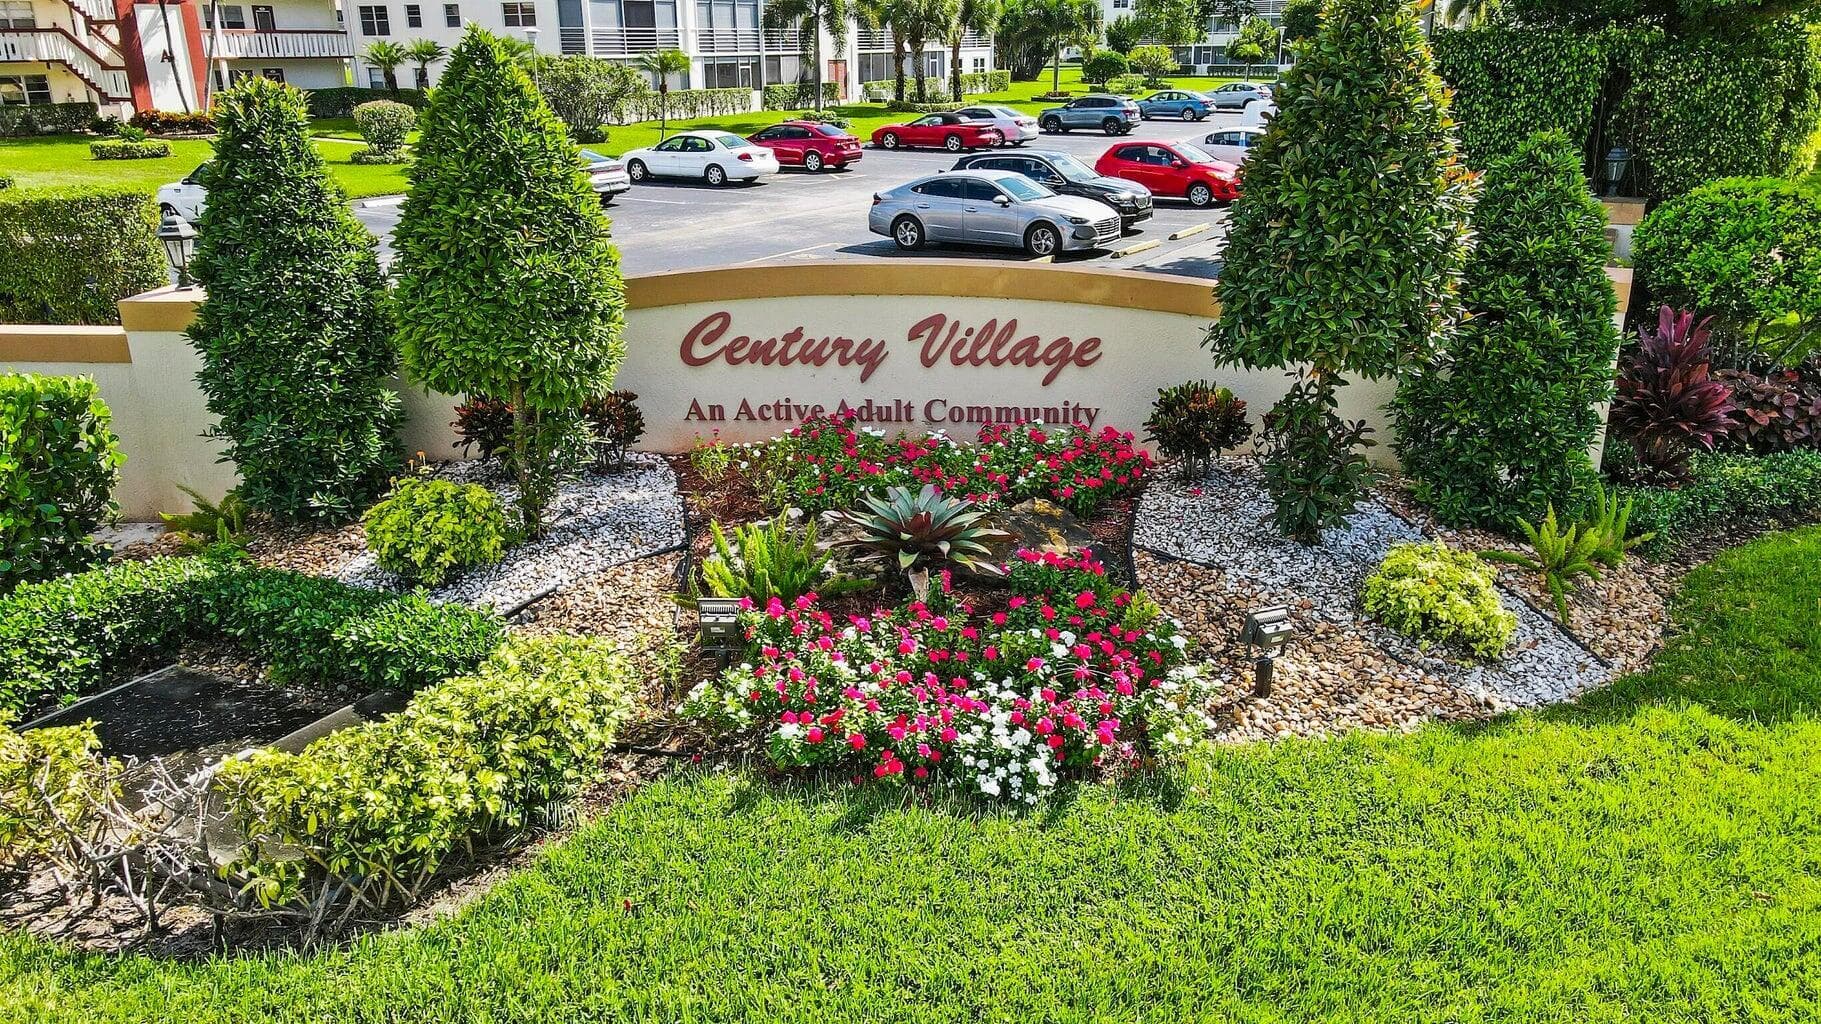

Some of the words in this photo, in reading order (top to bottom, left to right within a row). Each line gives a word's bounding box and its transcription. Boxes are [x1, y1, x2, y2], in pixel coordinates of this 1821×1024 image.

[680, 311, 889, 383] Century
[908, 313, 1102, 387] Village
[685, 397, 725, 421] An
[734, 397, 824, 422] Active
[835, 398, 914, 422] Adult
[924, 399, 1100, 427] Community
